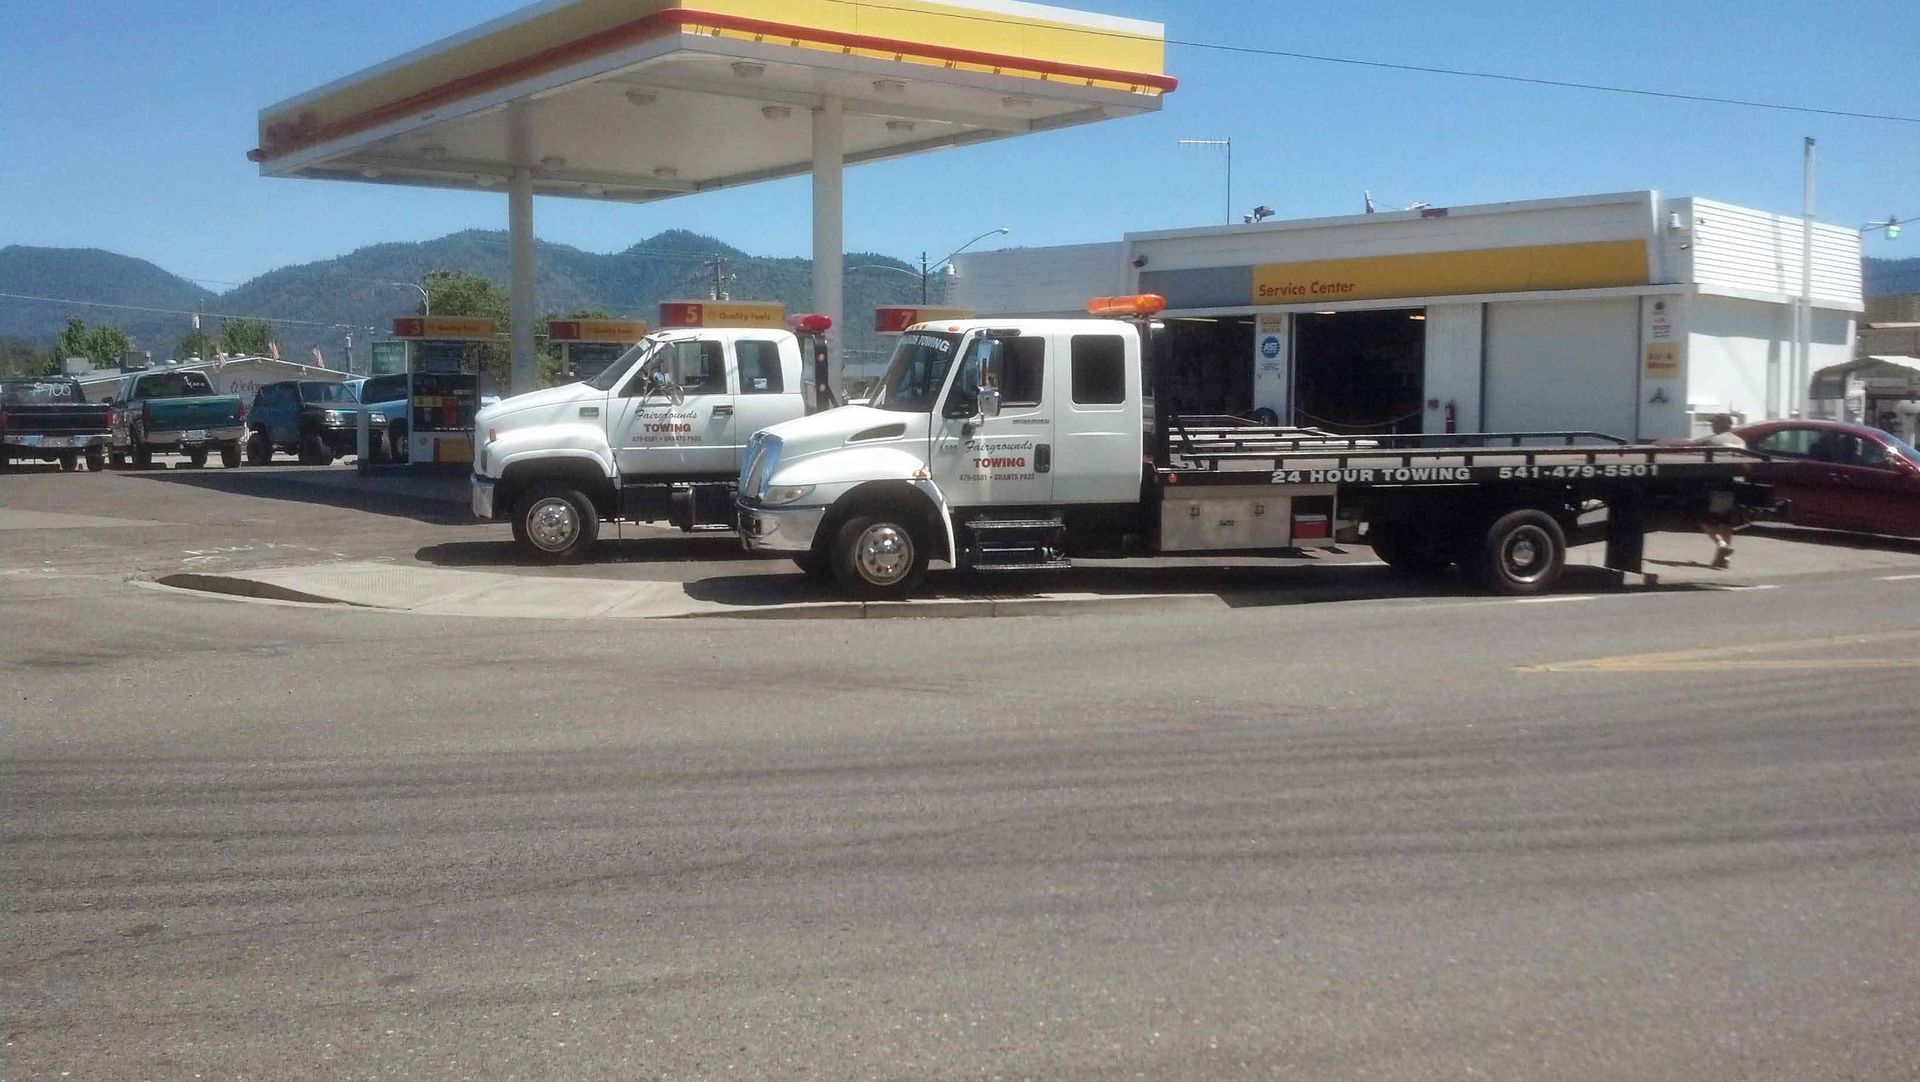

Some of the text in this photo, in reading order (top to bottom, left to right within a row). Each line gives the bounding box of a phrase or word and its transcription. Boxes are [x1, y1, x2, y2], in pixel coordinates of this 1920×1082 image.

[1258, 281, 1356, 297] Service Center
[685, 304, 698, 323] 5
[719, 311, 750, 321] Quality
[901, 311, 914, 329] 7
[411, 319, 421, 333] 3
[918, 334, 951, 352] TOWING
[634, 409, 698, 421] Fairgrounds
[643, 423, 691, 433] TOWING
[964, 440, 1033, 454] Fairgrounds
[973, 457, 1026, 468] TOWING
[994, 473, 1018, 481] GRANTS
[1019, 472, 1035, 480] PASS
[1271, 464, 1659, 484] 24 HOUR TOWING 541-479-5501
